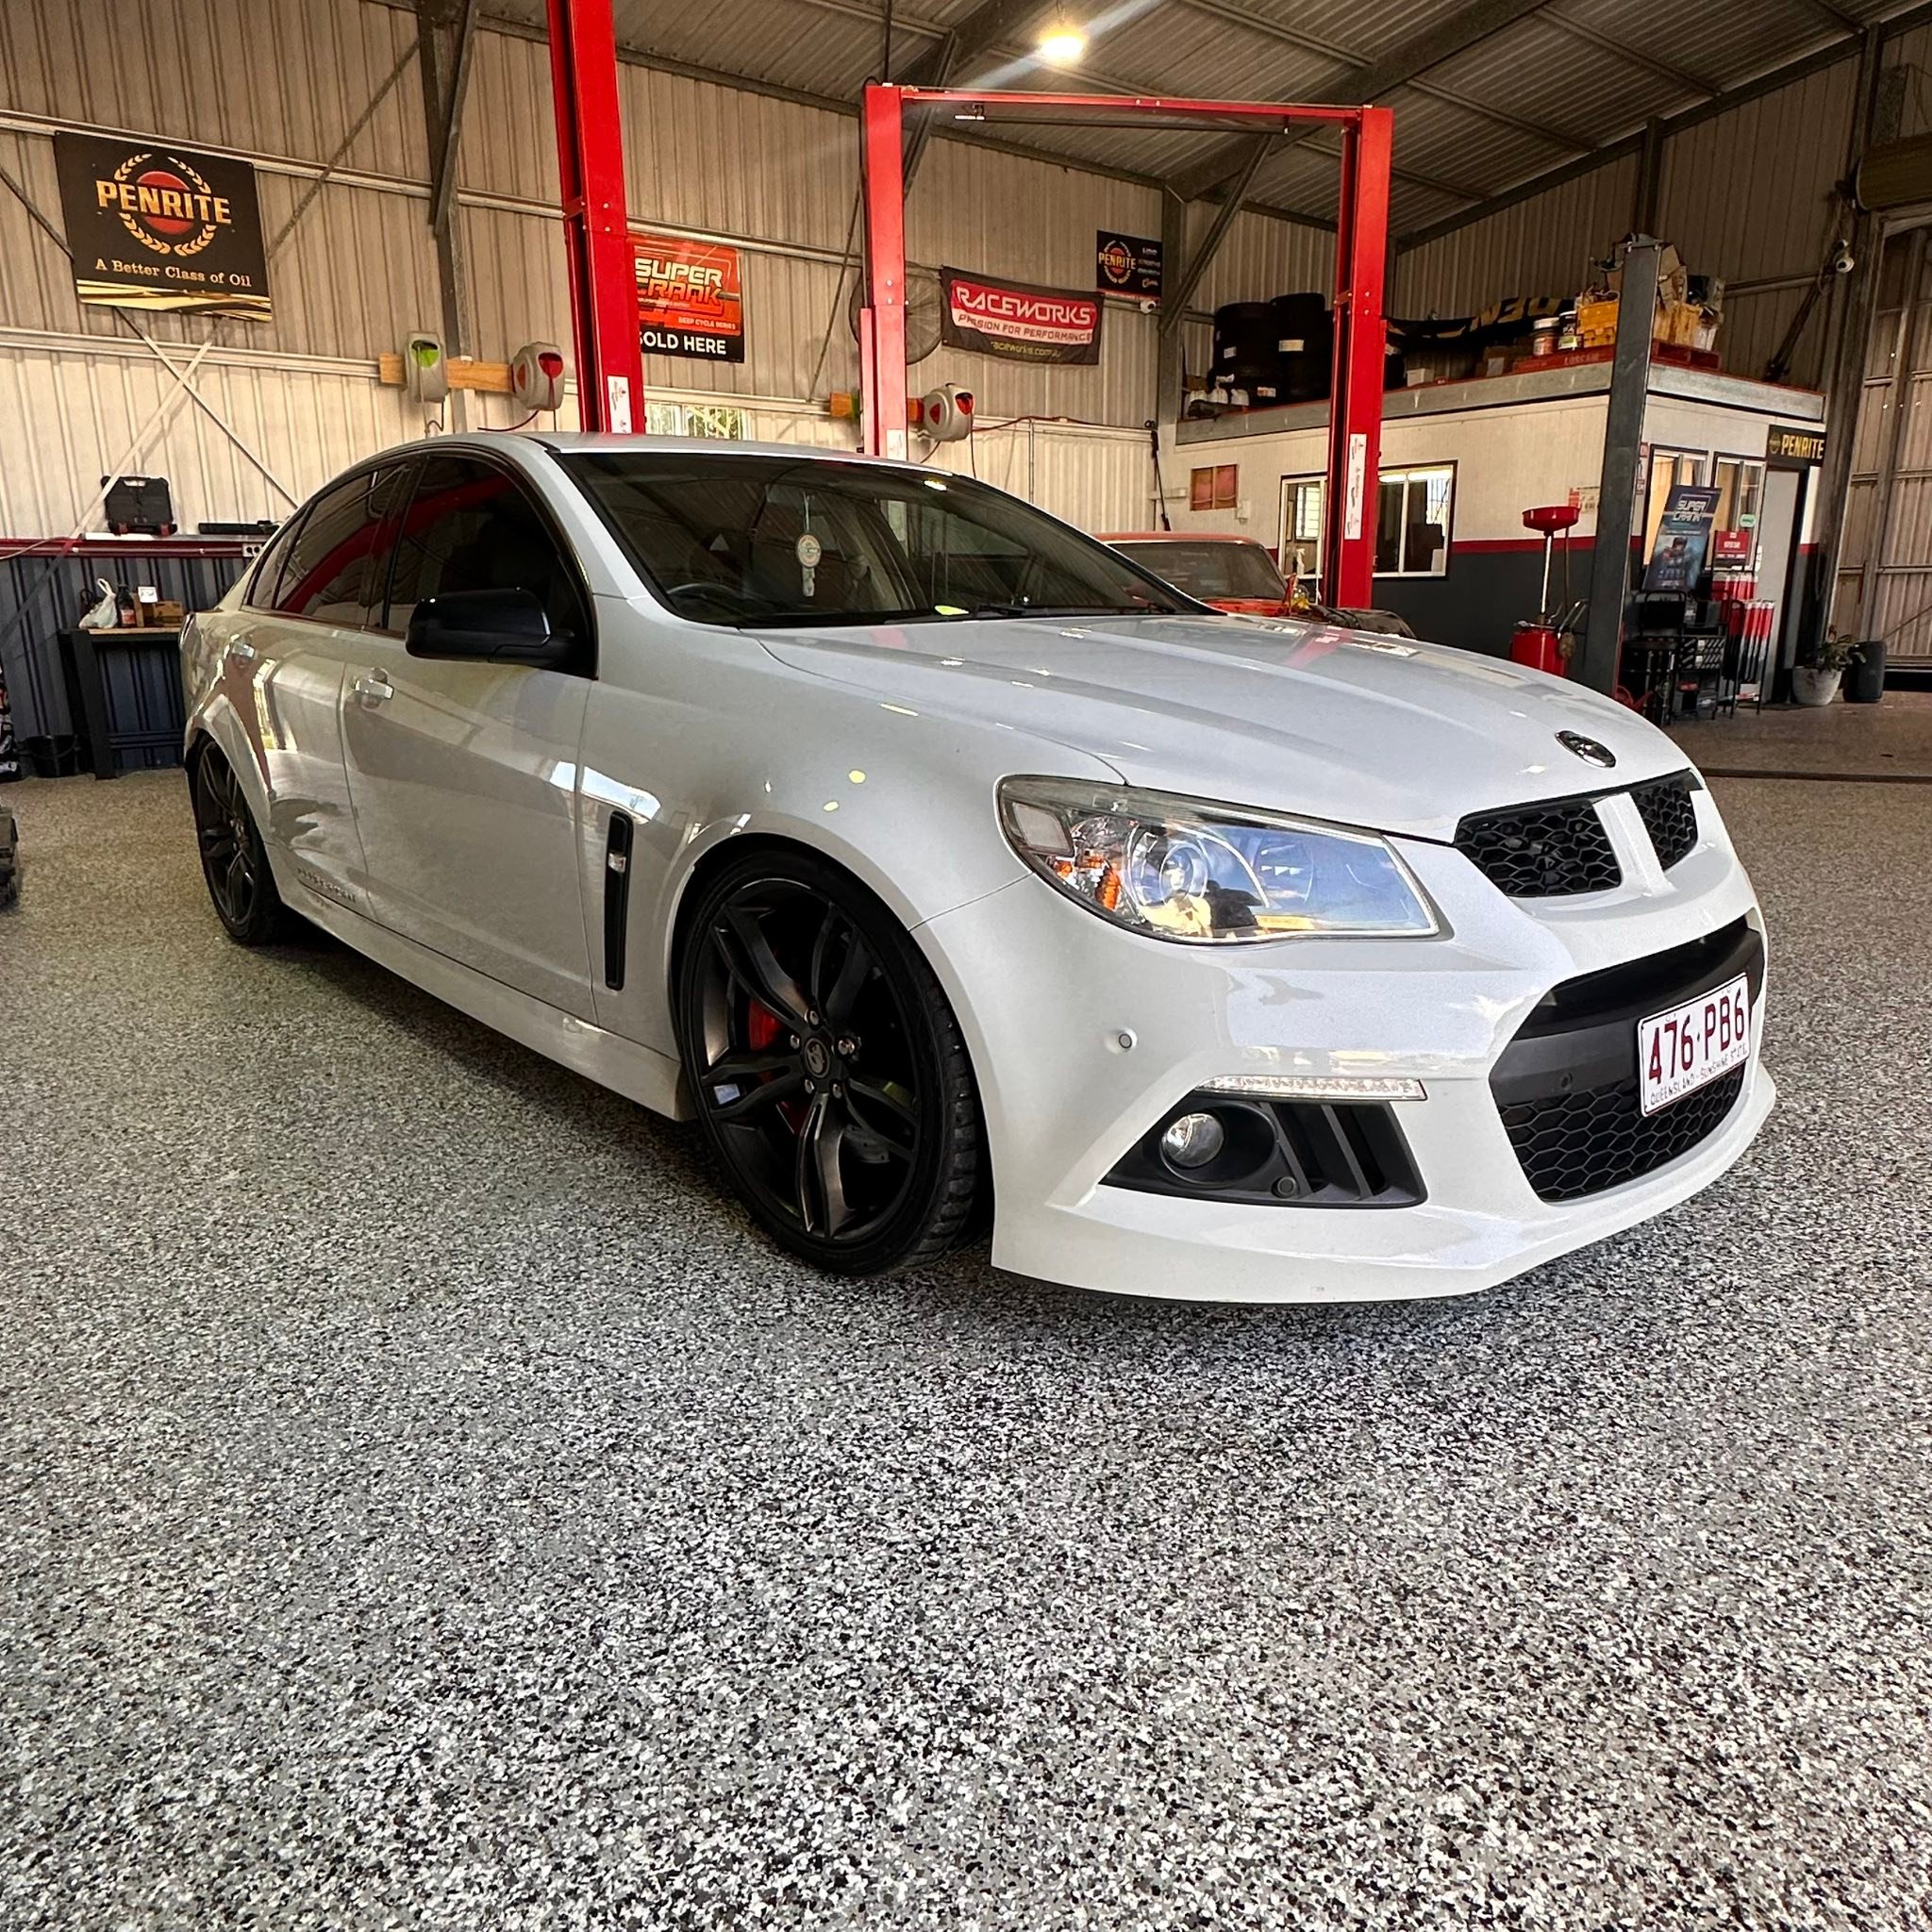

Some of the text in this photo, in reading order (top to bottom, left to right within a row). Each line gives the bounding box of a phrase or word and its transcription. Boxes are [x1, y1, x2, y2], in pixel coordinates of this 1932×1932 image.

[96, 180, 231, 224] PENRITE
[95, 258, 252, 287] A Better Class of Oil
[635, 258, 723, 287] SUPER
[1098, 252, 1136, 270] PENRITE
[956, 286, 1091, 325] RACEWORKS
[678, 316, 694, 325] DEEP
[695, 319, 714, 327] CYCLE
[1003, 324, 1021, 336] FOR
[1024, 328, 1091, 342] PERFORMANCE
[684, 335, 726, 355] HERE
[1781, 434, 1825, 459] PENRITE
